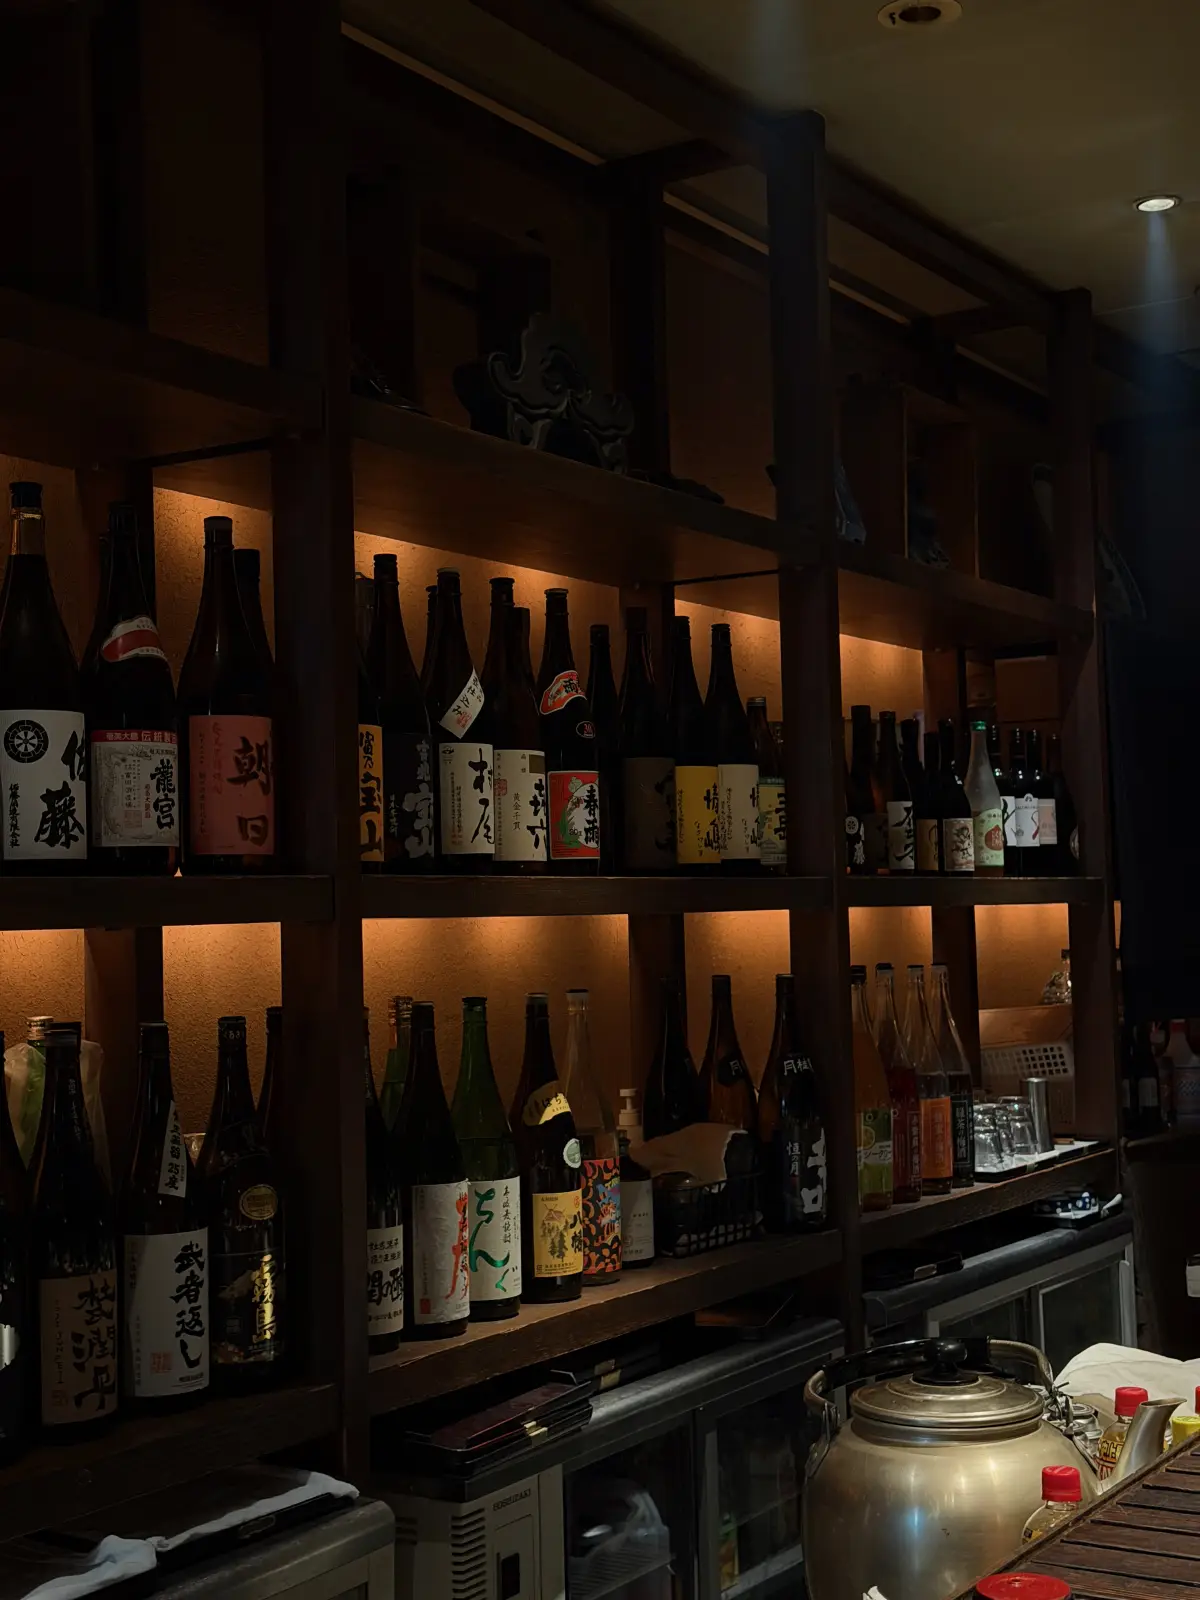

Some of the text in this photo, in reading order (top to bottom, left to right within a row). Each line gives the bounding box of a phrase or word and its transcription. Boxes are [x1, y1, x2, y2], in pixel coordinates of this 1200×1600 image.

[150, 759, 176, 830] 龍宮
[227, 736, 271, 847] 朝日
[468, 748, 495, 845] 村尾
[469, 1188, 519, 1292] ちんぐ
[169, 1240, 205, 1369] 武者返し
